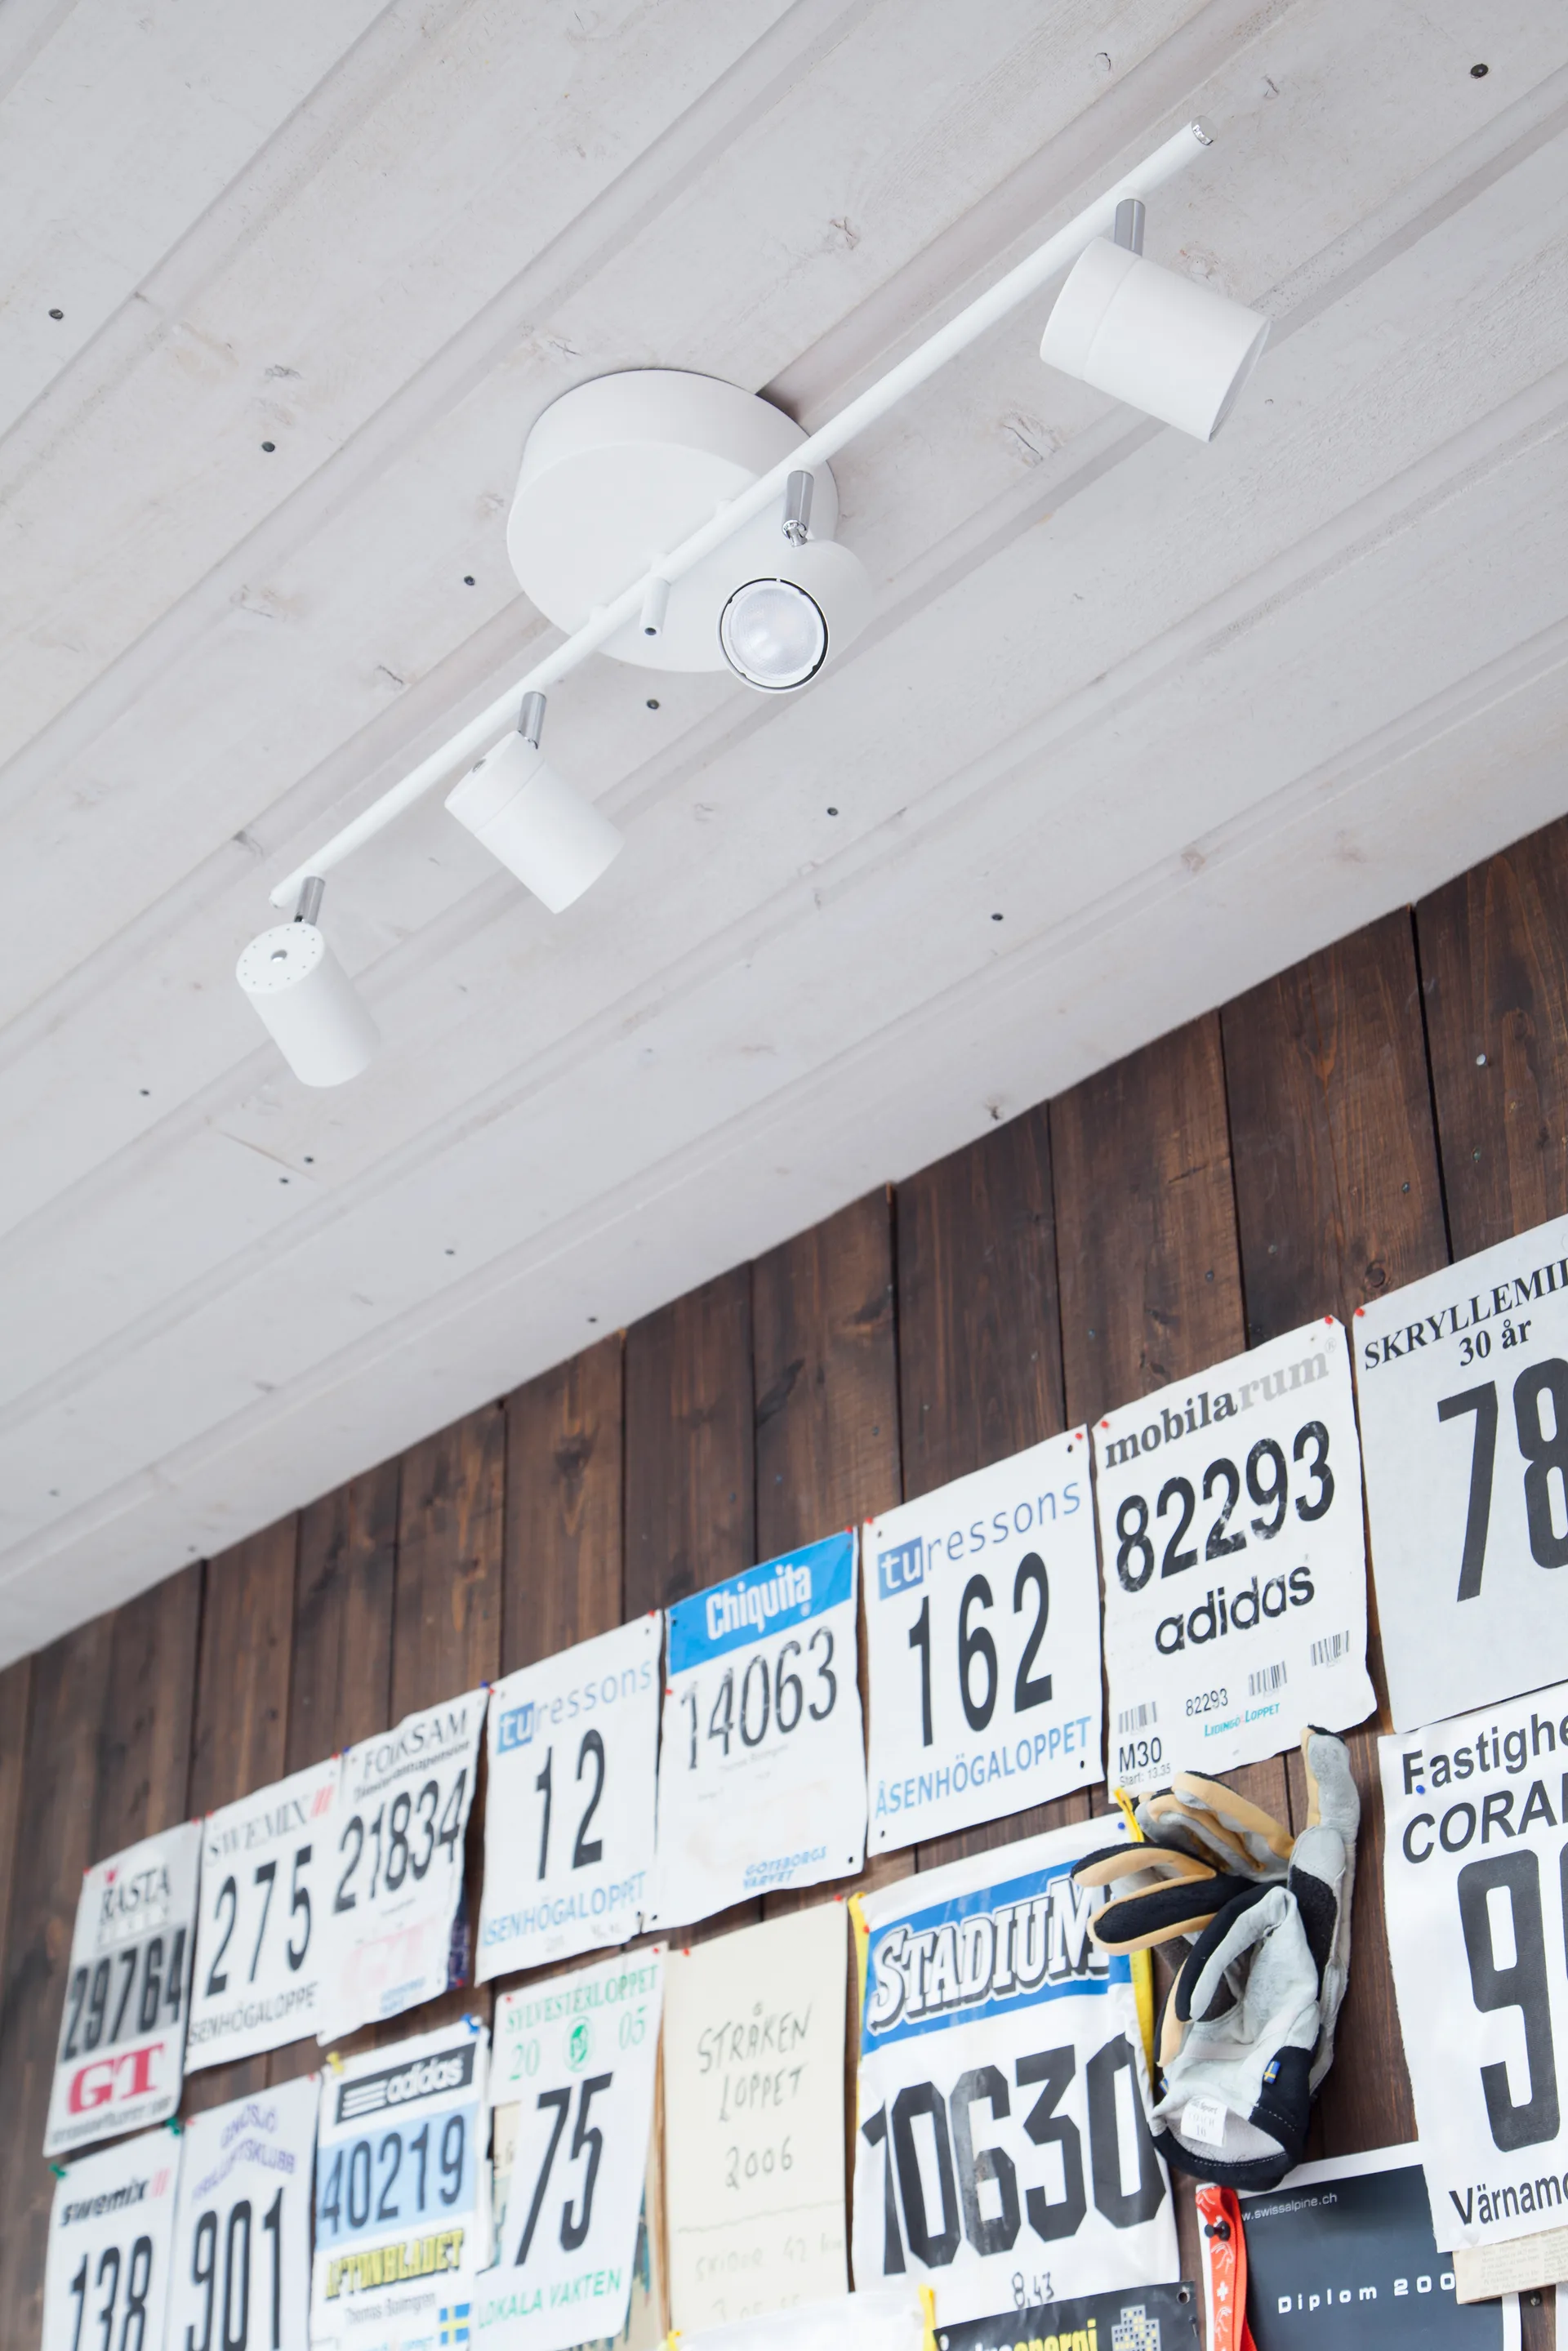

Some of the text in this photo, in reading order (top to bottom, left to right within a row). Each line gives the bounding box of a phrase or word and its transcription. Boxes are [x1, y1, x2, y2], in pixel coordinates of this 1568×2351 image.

[1460, 1316, 1532, 1367] 30 år
[1105, 1351, 1330, 1469] mobilarum
[880, 1482, 1081, 1592] turessons
[1116, 1420, 1336, 1592] 82293
[706, 1563, 812, 1640] Chiquita
[909, 1552, 1053, 1748] 162
[1155, 1565, 1316, 1655] adidas
[498, 1660, 653, 1749] turessons
[680, 1626, 838, 1770] 14063
[1186, 1688, 1229, 1716] 82293
[535, 1729, 605, 1881] 12
[875, 1715, 1092, 1819] ÅSENHÖGALOPPET
[1120, 1737, 1163, 1774] M30
[331, 1768, 469, 1917] 21834
[1402, 1772, 1568, 1864] CORA
[204, 1844, 313, 1997] 275
[868, 1877, 1109, 2034] STADIUM
[62, 1928, 187, 2062] 29764
[1459, 1842, 1568, 2153] 9
[68, 2042, 165, 2115] GT
[387, 2053, 464, 2104] adidas
[509, 2037, 541, 2082] 20
[718, 2065, 803, 2122] LOPPET
[318, 2113, 466, 2235] 40219
[514, 2071, 613, 2268] 75
[724, 2135, 793, 2189] 2006
[862, 2033, 1166, 2275] 10630
[68, 2234, 153, 2351] 138
[187, 2187, 283, 2351] 901
[1277, 2285, 1377, 2314] Diplom
